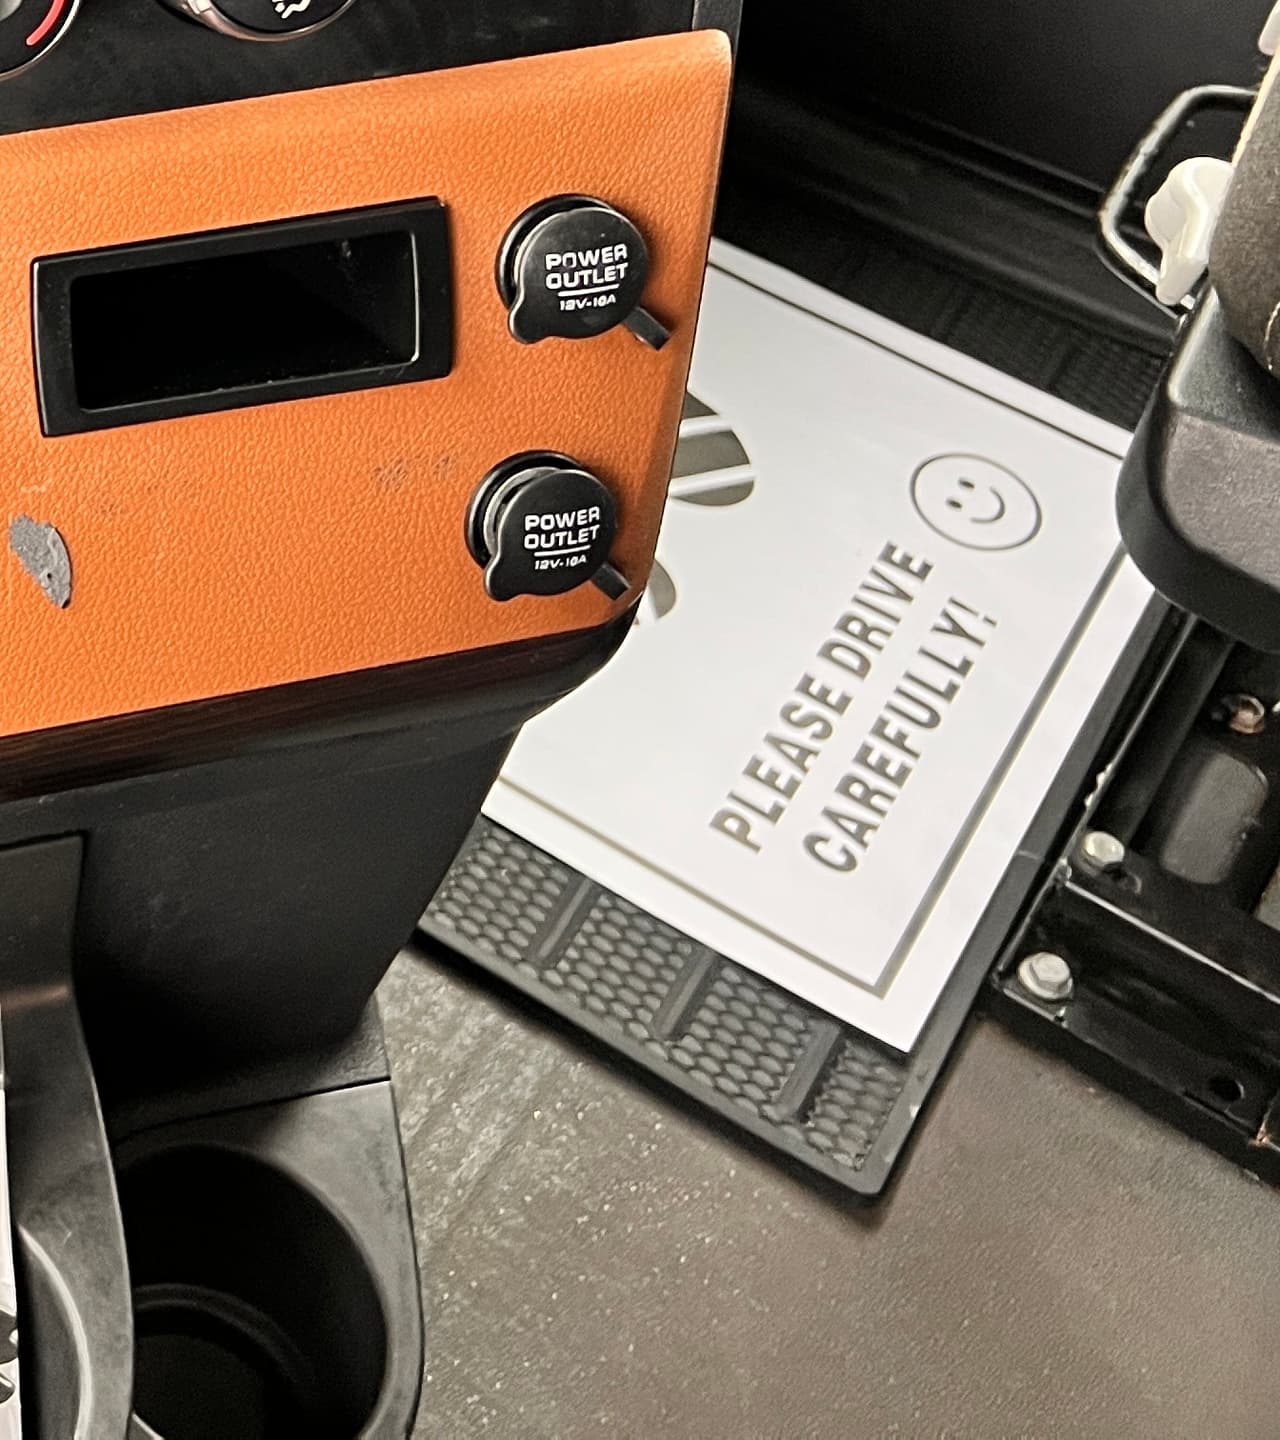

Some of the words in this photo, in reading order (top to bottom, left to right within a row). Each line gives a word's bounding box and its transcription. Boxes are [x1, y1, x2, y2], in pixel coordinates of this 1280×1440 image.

[545, 243, 628, 270] POWER
[546, 263, 628, 289] OUTLET
[525, 506, 600, 531] POWER
[524, 524, 600, 549] OUTLET
[709, 672, 851, 854] PLEASE
[817, 540, 936, 685] DRIVE
[801, 596, 999, 875] CAREFULLY!
